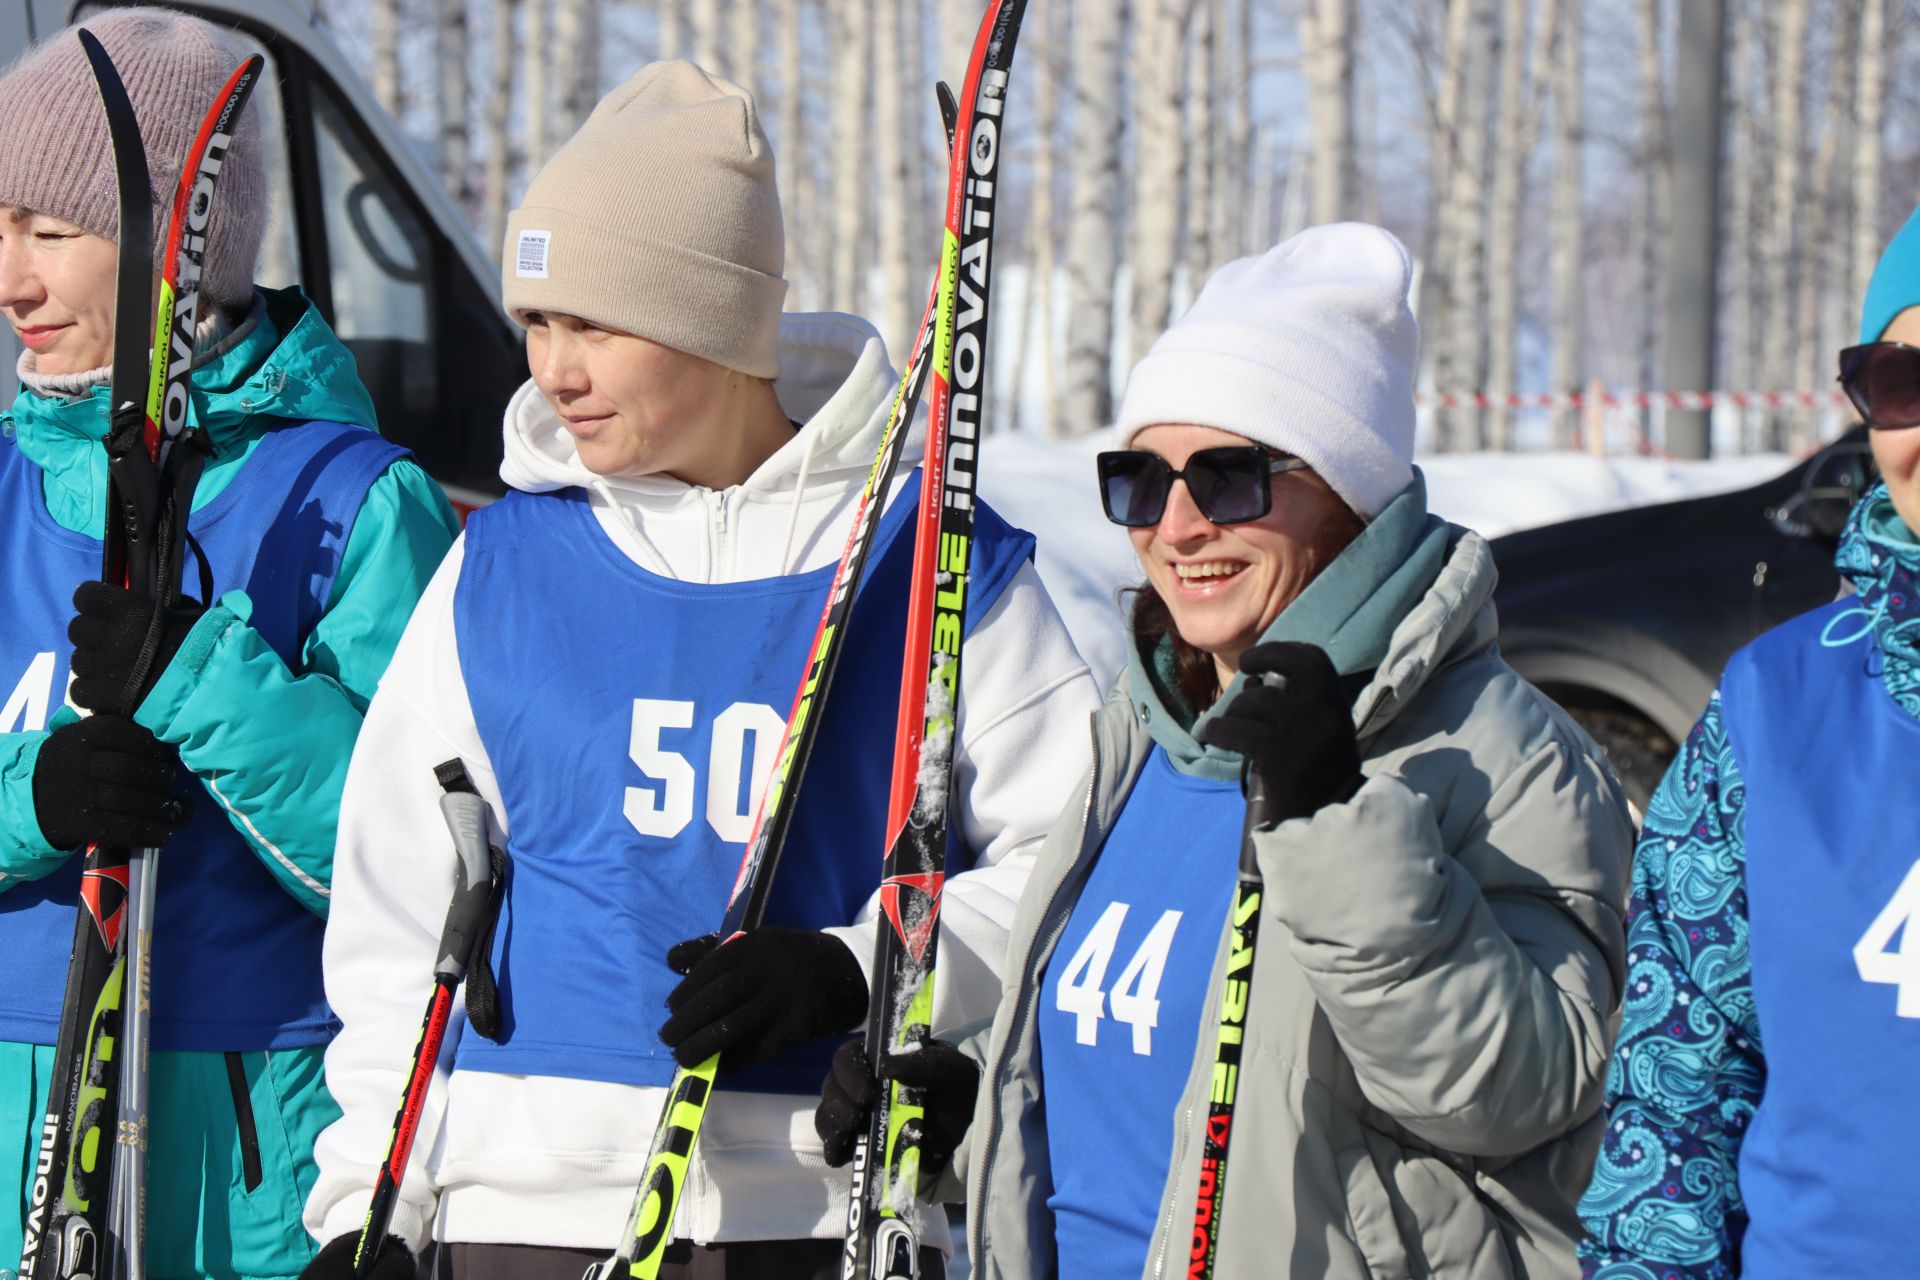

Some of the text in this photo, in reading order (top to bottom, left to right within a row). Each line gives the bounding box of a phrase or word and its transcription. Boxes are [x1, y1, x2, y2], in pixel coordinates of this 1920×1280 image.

[154, 295, 174, 422] TECHNOLOGY
[942, 243, 958, 373] TECHNOLOGY
[930, 390, 947, 519] LIGHT SPORT
[623, 698, 788, 843] 50
[1056, 901, 1184, 1057] 44
[65, 1053, 83, 1132] NANOBASE
